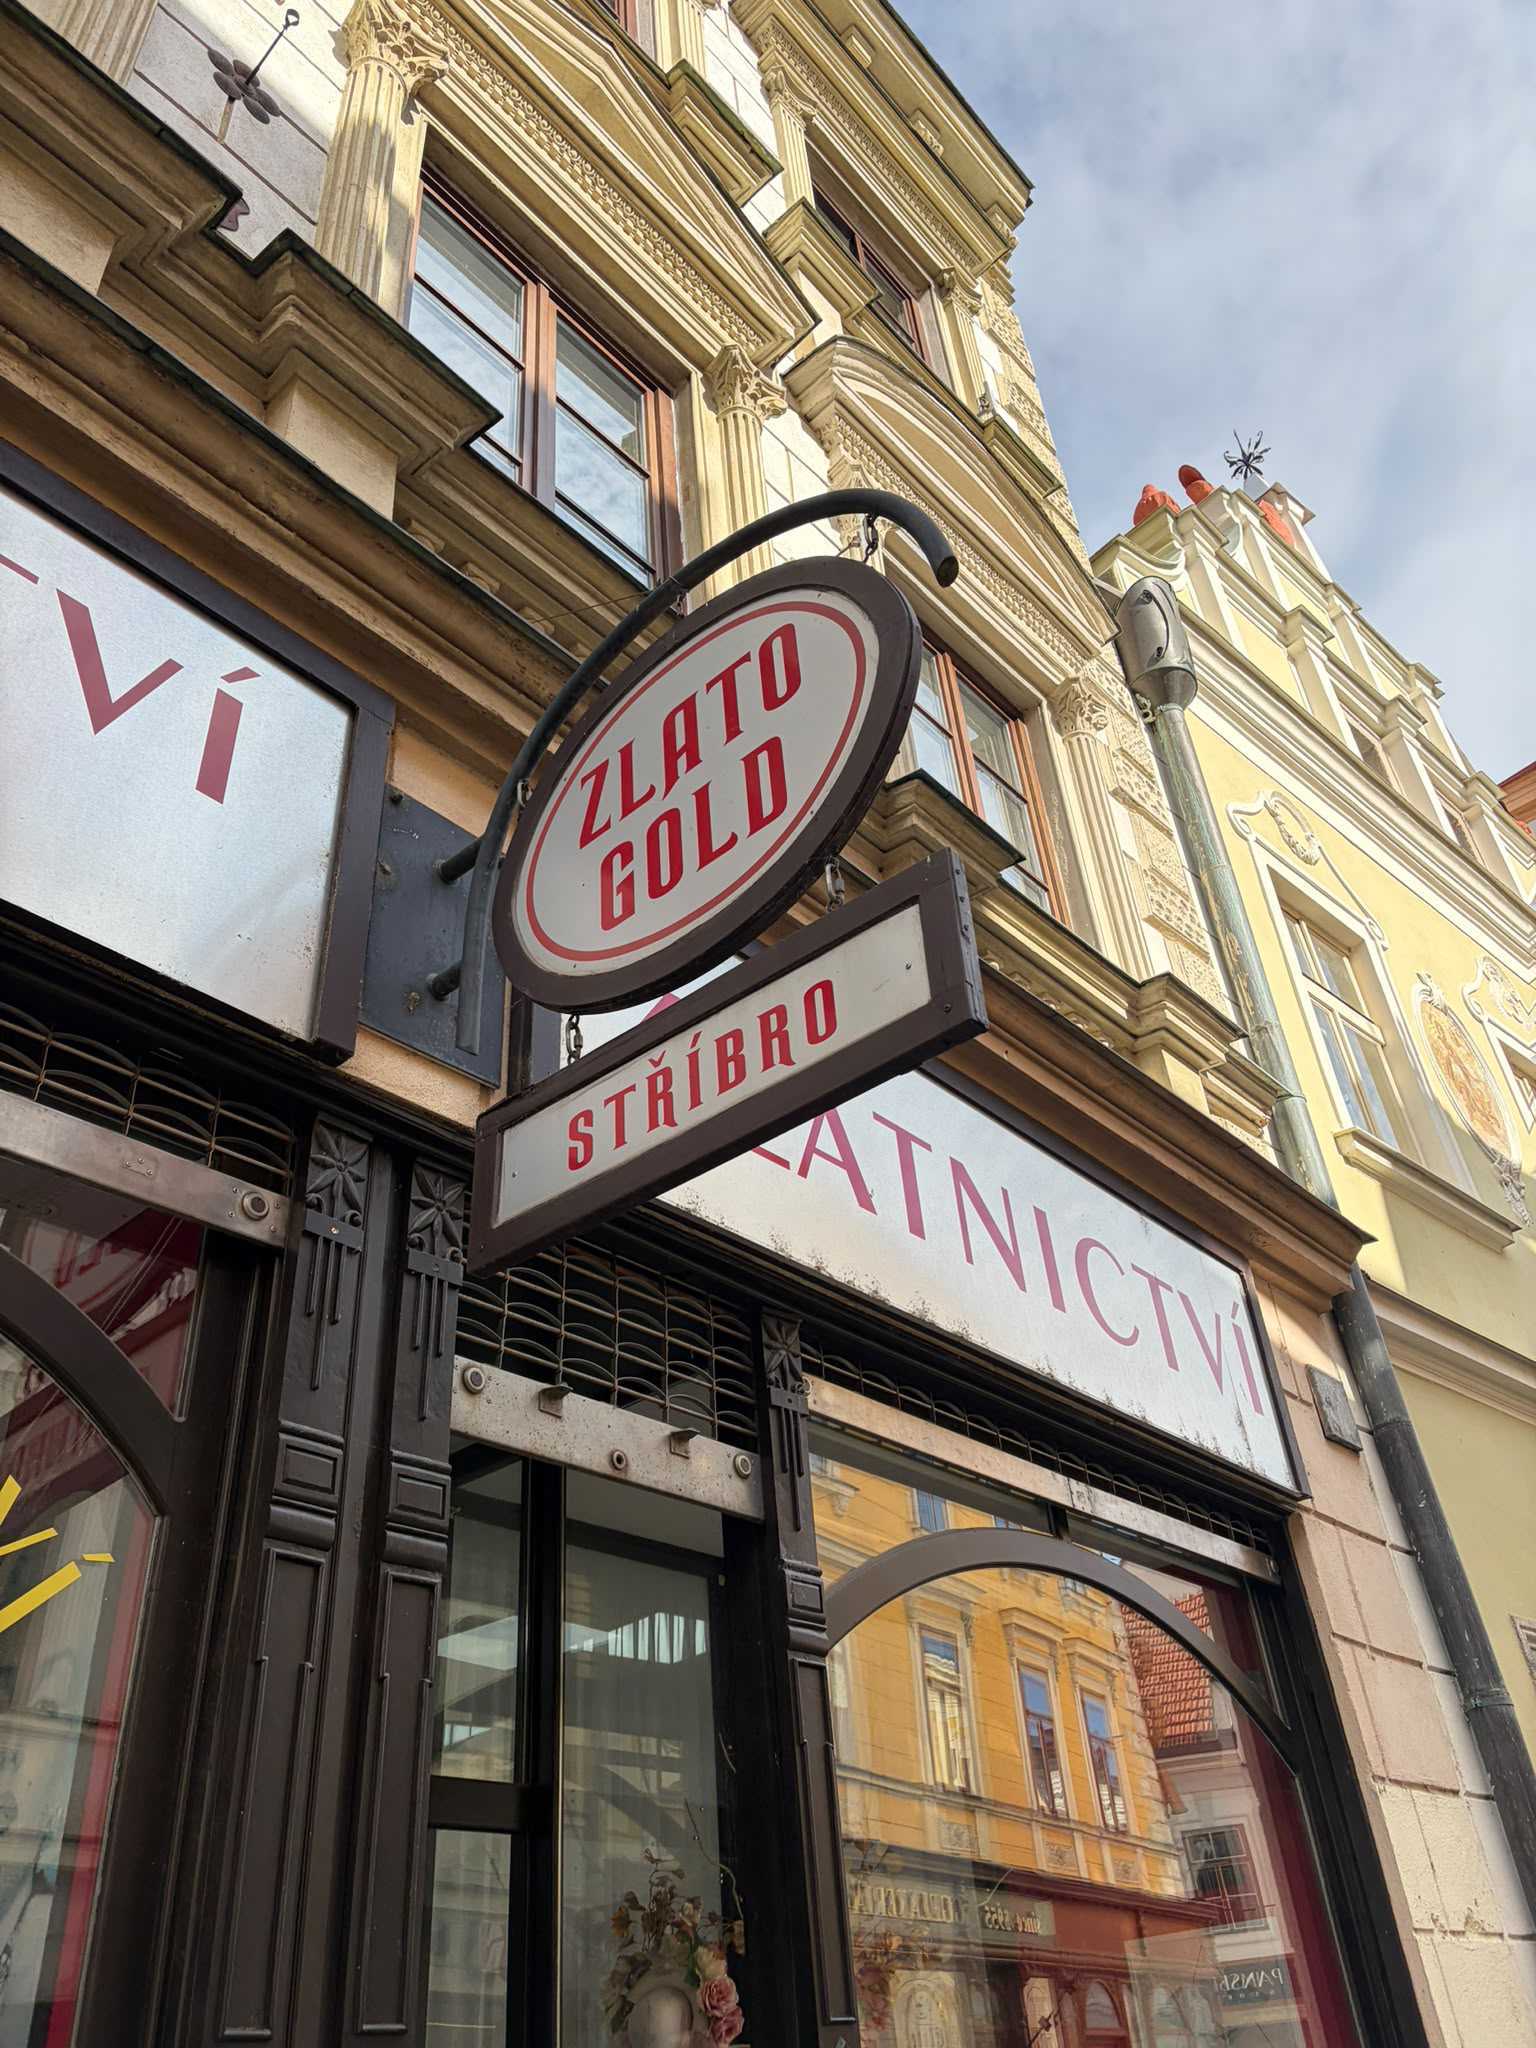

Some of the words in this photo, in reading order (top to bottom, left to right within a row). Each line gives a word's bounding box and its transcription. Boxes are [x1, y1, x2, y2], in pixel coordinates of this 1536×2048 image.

[0, 554, 262, 806] VÍ
[578, 622, 802, 850] ZLATO
[600, 735, 789, 932] GOLD
[567, 979, 838, 1172] STŘÍBRO
[640, 992, 1265, 1416] ATNICTVÍ
